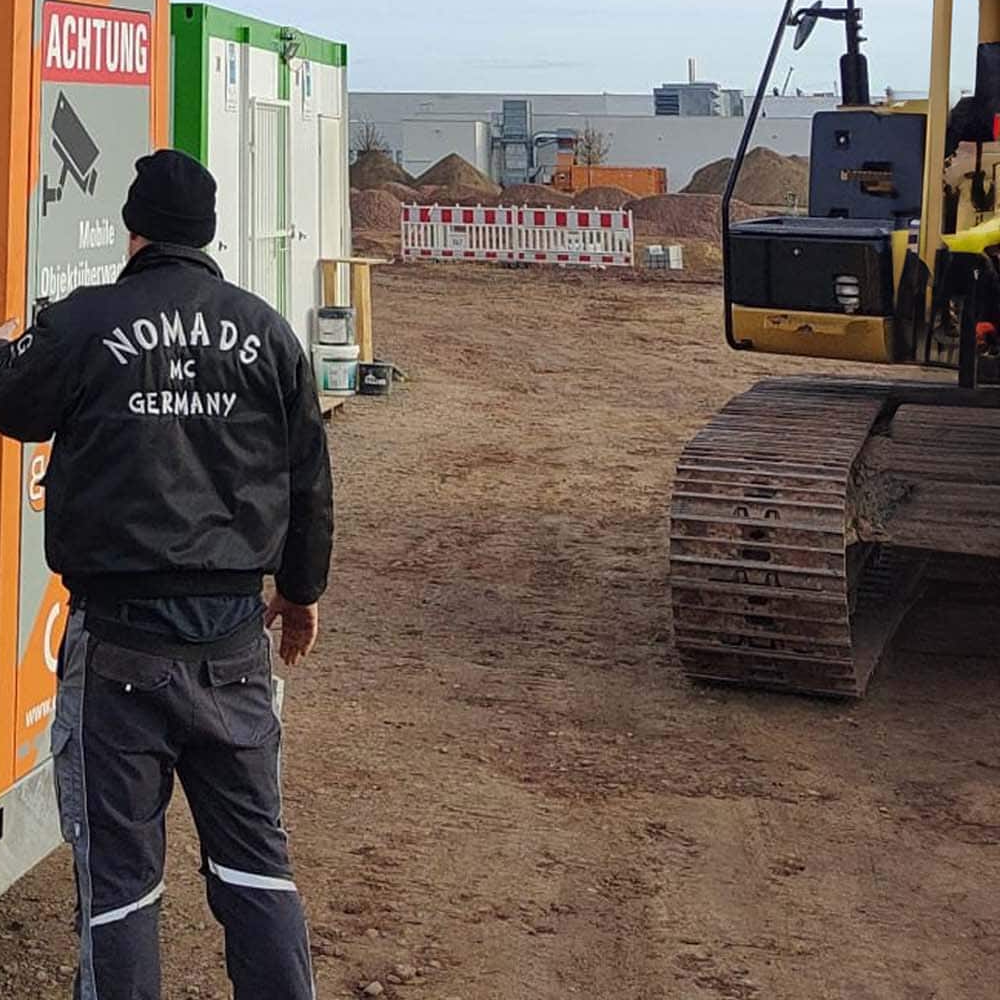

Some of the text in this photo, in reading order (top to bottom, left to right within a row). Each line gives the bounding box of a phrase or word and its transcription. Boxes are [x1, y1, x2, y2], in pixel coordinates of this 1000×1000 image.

[46, 14, 148, 74] ACHTUNG
[80, 219, 115, 249] Mobile
[102, 309, 261, 365] NOMADS
[169, 358, 196, 381] MC
[128, 390, 236, 417] GERMANY
